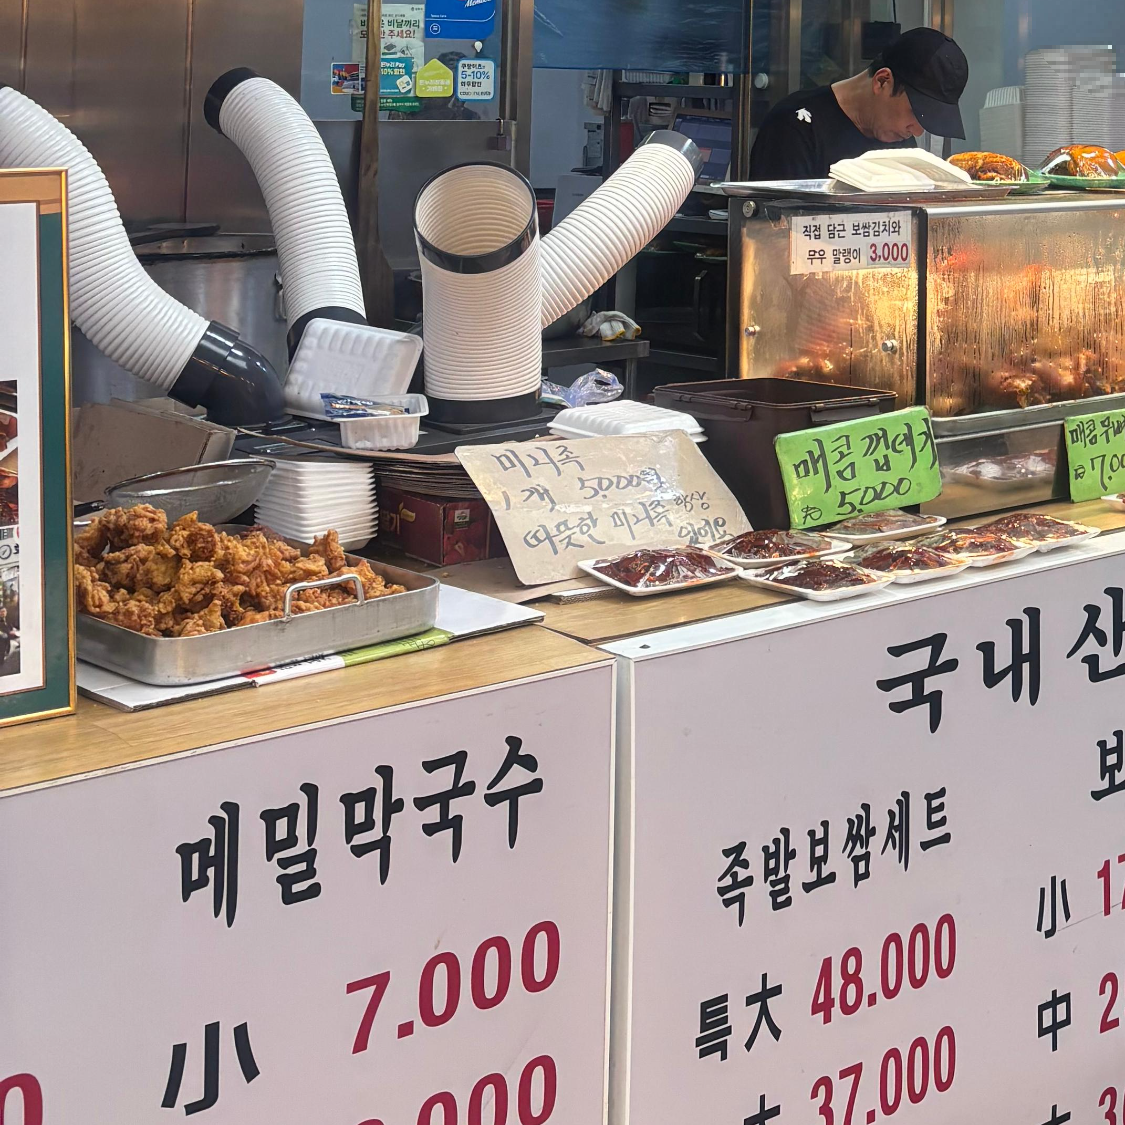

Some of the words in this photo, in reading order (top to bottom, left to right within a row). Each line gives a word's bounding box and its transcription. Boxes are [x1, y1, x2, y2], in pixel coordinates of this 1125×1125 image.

[461, 70, 490, 80] 5-10%
[803, 224, 821, 240] 직접
[827, 223, 846, 239] 담근
[852, 220, 901, 237] 보쌈김치와
[807, 249, 827, 265] 무우
[832, 247, 861, 265] 말랭이
[869, 242, 909, 263] 3,000
[793, 434, 857, 495] 매콤
[174, 734, 545, 929] 메밀막국수
[715, 786, 953, 928] 족발보쌈세트
[1036, 875, 1072, 939] 小
[810, 912, 958, 1026] 48.000
[160, 1019, 261, 1117] 小
[345, 919, 562, 1056] 7.000
[1037, 989, 1072, 1052] 中
[810, 1025, 957, 1125] 37.000
